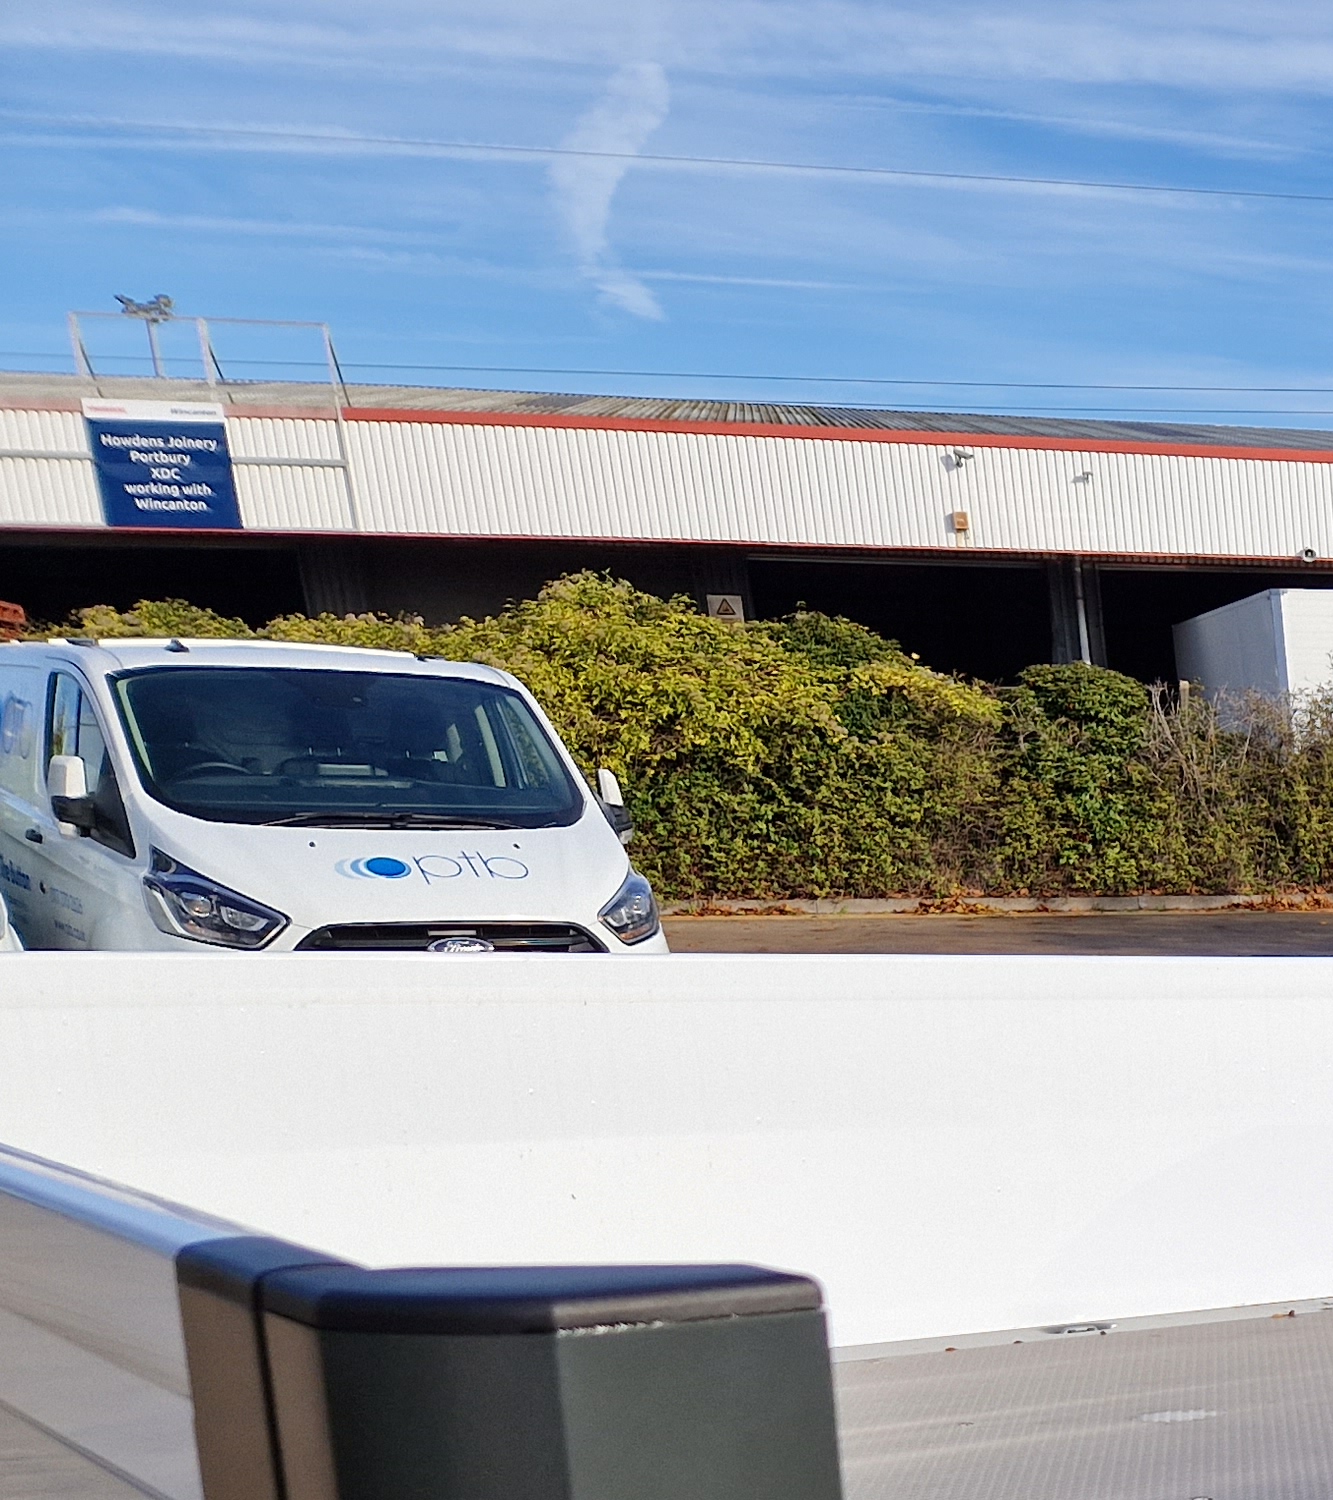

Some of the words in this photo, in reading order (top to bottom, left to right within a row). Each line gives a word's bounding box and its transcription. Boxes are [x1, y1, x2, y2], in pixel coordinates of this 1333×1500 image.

[100, 433, 165, 448] Howdens
[167, 436, 217, 451] Joinery
[129, 450, 191, 466] Portbury
[151, 468, 182, 480] XDC
[124, 482, 180, 497] working
[182, 483, 213, 496] with
[134, 498, 208, 511] Wincanton
[412, 850, 529, 885] ptb
